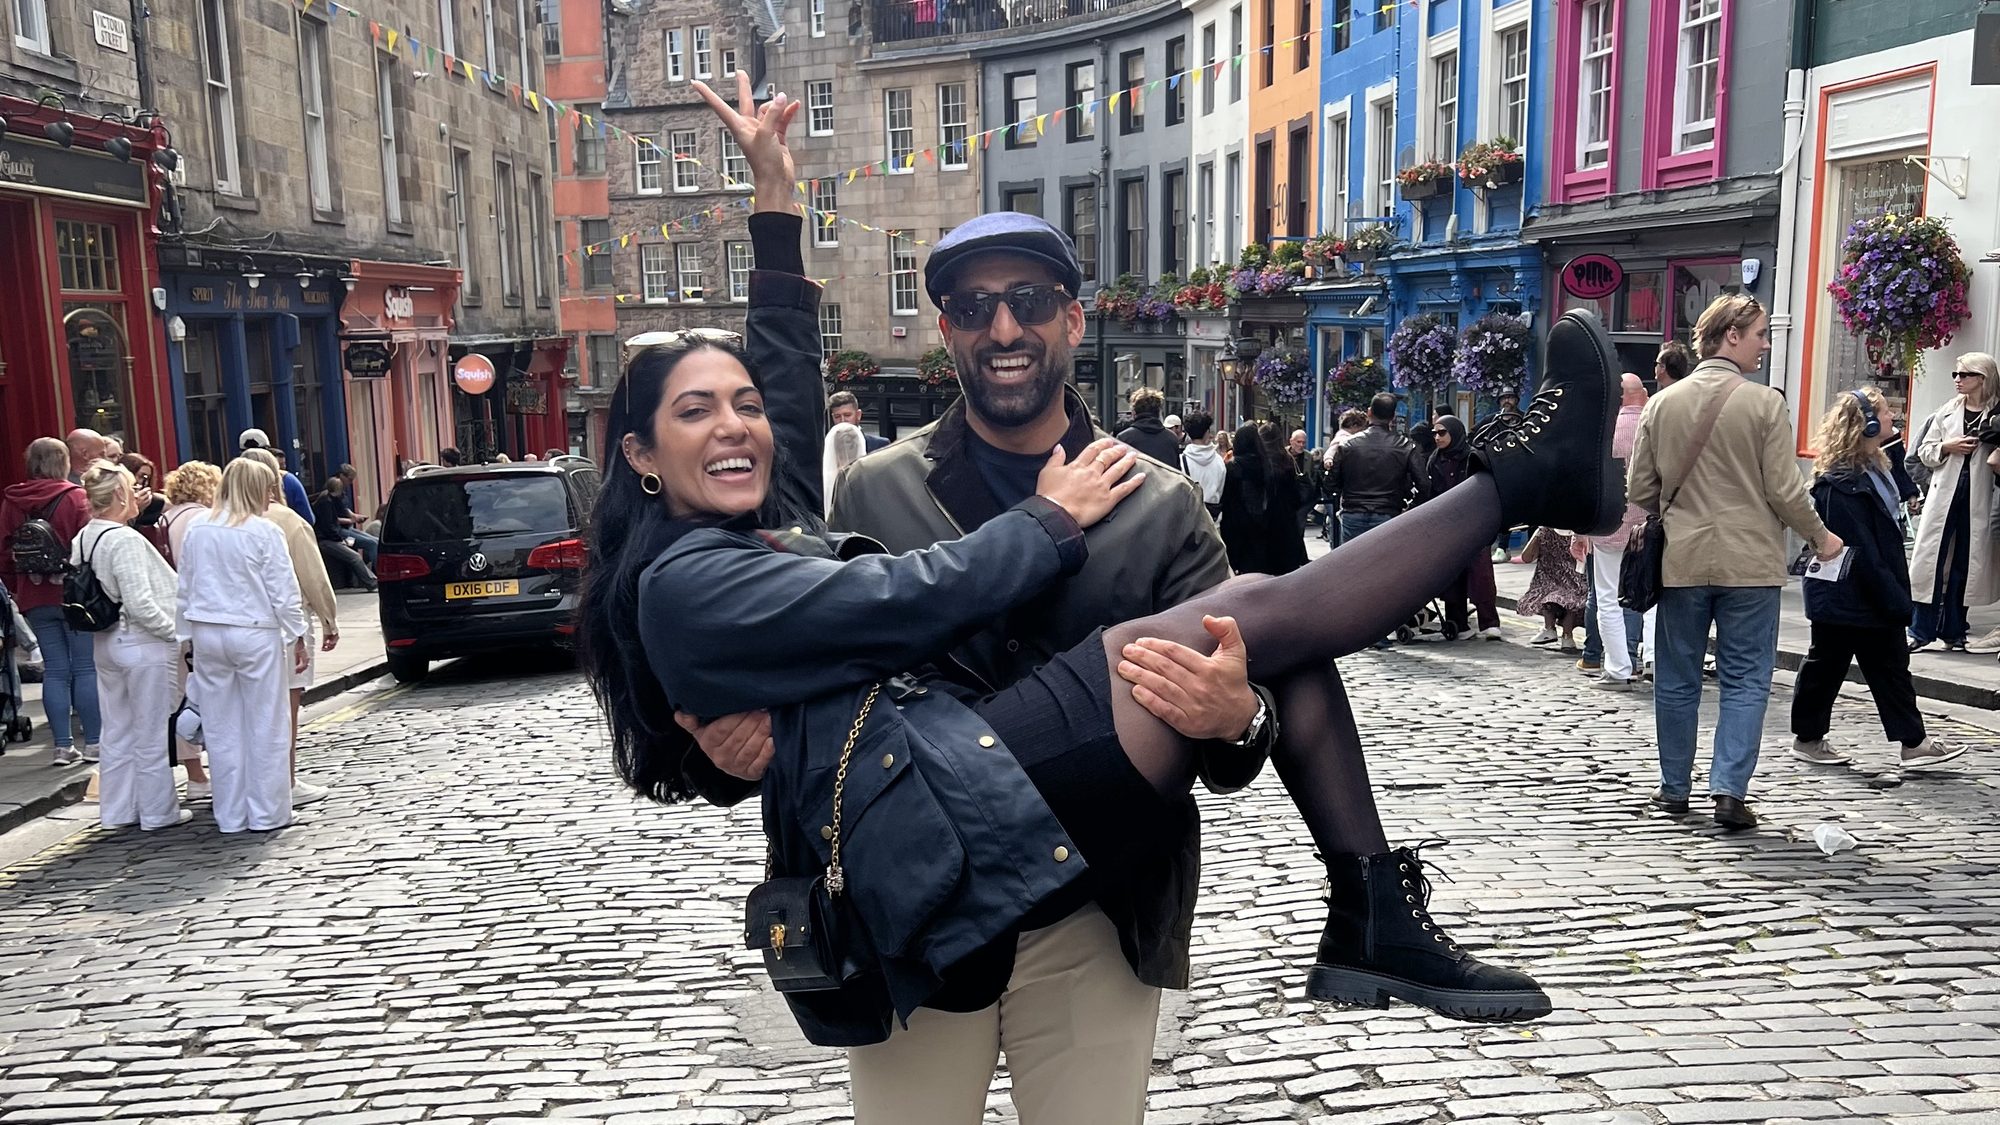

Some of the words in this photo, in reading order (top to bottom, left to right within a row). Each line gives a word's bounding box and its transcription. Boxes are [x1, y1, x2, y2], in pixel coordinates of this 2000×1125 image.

[95, 12, 125, 36] VICTORIA
[101, 30, 123, 48] STREET
[1863, 184, 1899, 199] Edinburgh
[1273, 183, 1289, 227] 40
[224, 280, 242, 310] The
[385, 288, 413, 322] Squish
[457, 368, 492, 381] Squish
[453, 584, 482, 596] OX16
[485, 582, 510, 594] CDF
